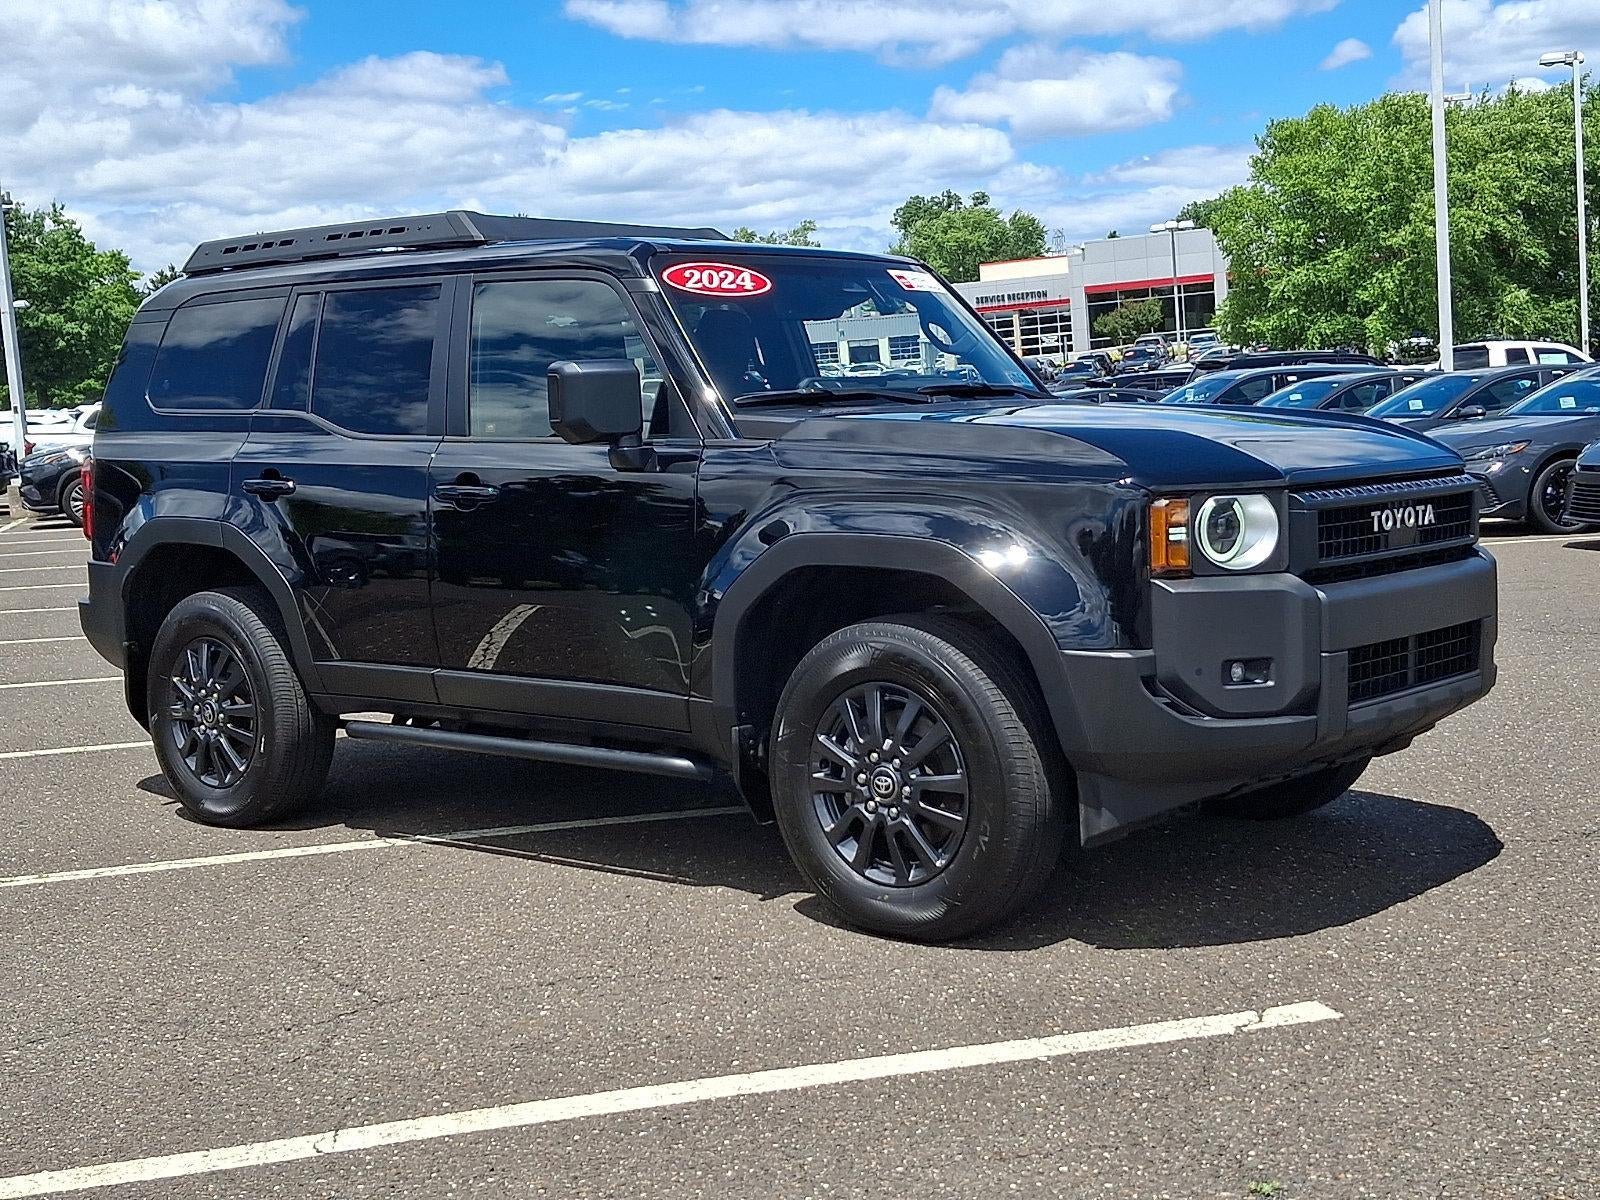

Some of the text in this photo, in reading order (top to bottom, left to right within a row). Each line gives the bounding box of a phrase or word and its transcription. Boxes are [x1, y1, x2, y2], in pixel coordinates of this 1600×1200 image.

[684, 269, 756, 290] 2024
[975, 290, 1048, 304] SERVICE RECEPTION
[1371, 504, 1435, 532] TOYOTA
